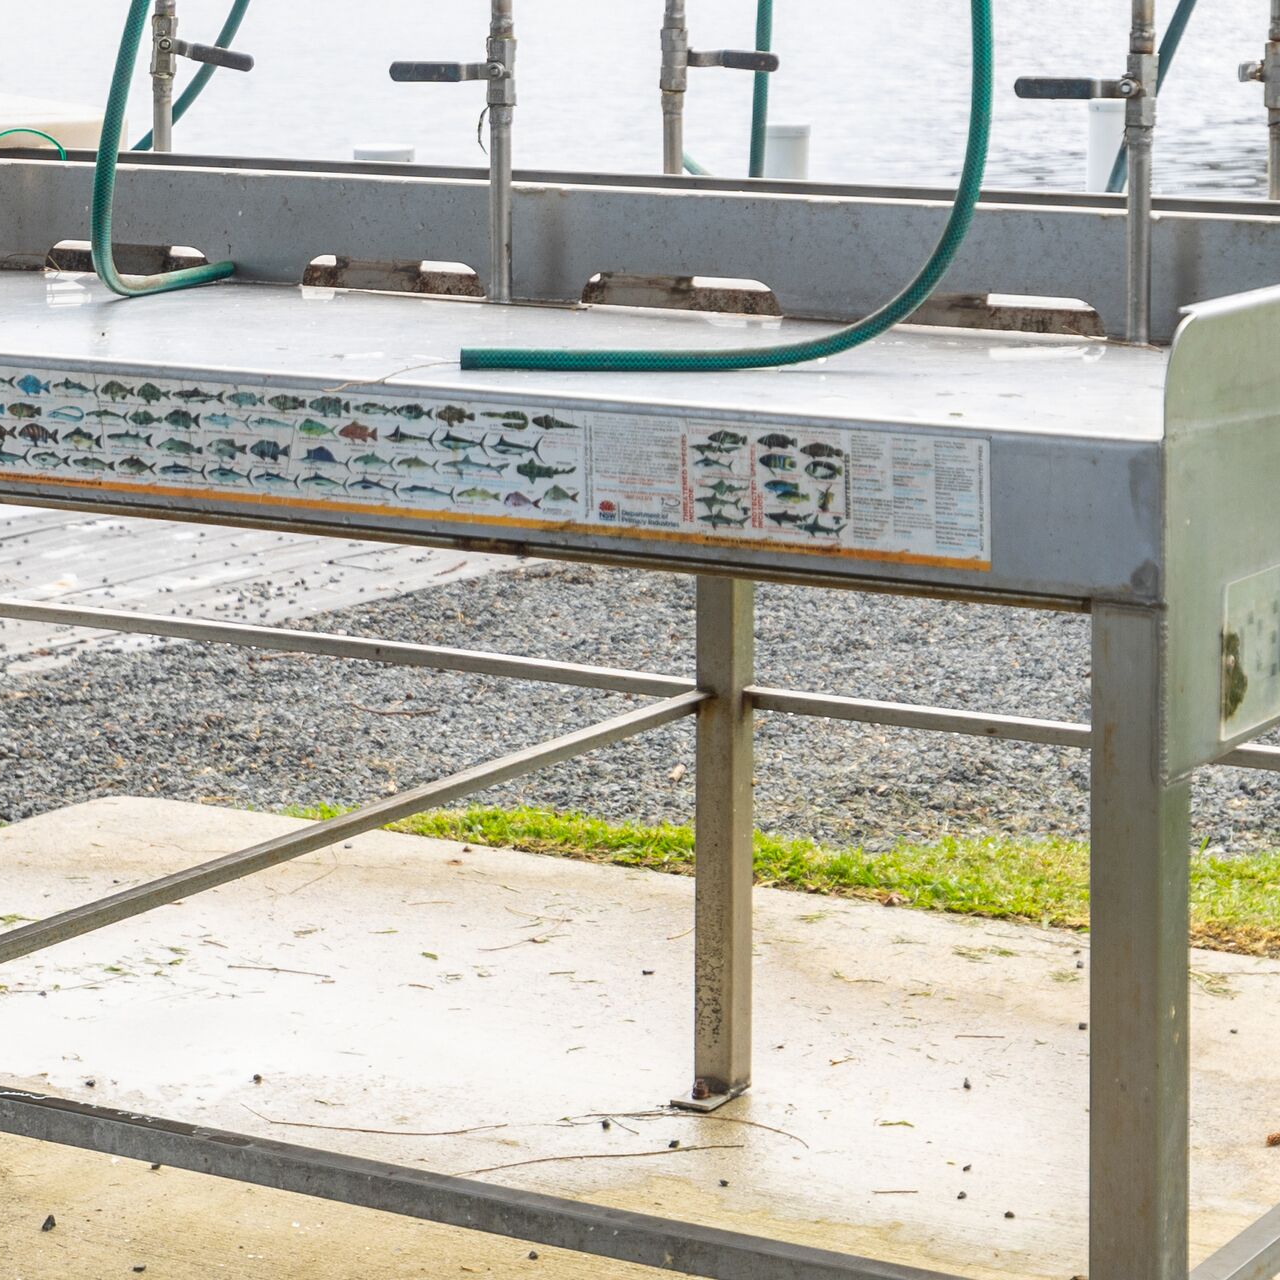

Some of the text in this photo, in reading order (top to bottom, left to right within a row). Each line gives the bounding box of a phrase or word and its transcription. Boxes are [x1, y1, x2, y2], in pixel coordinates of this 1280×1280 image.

[621, 509, 661, 520] Department
[621, 516, 680, 528] Primary Industries
